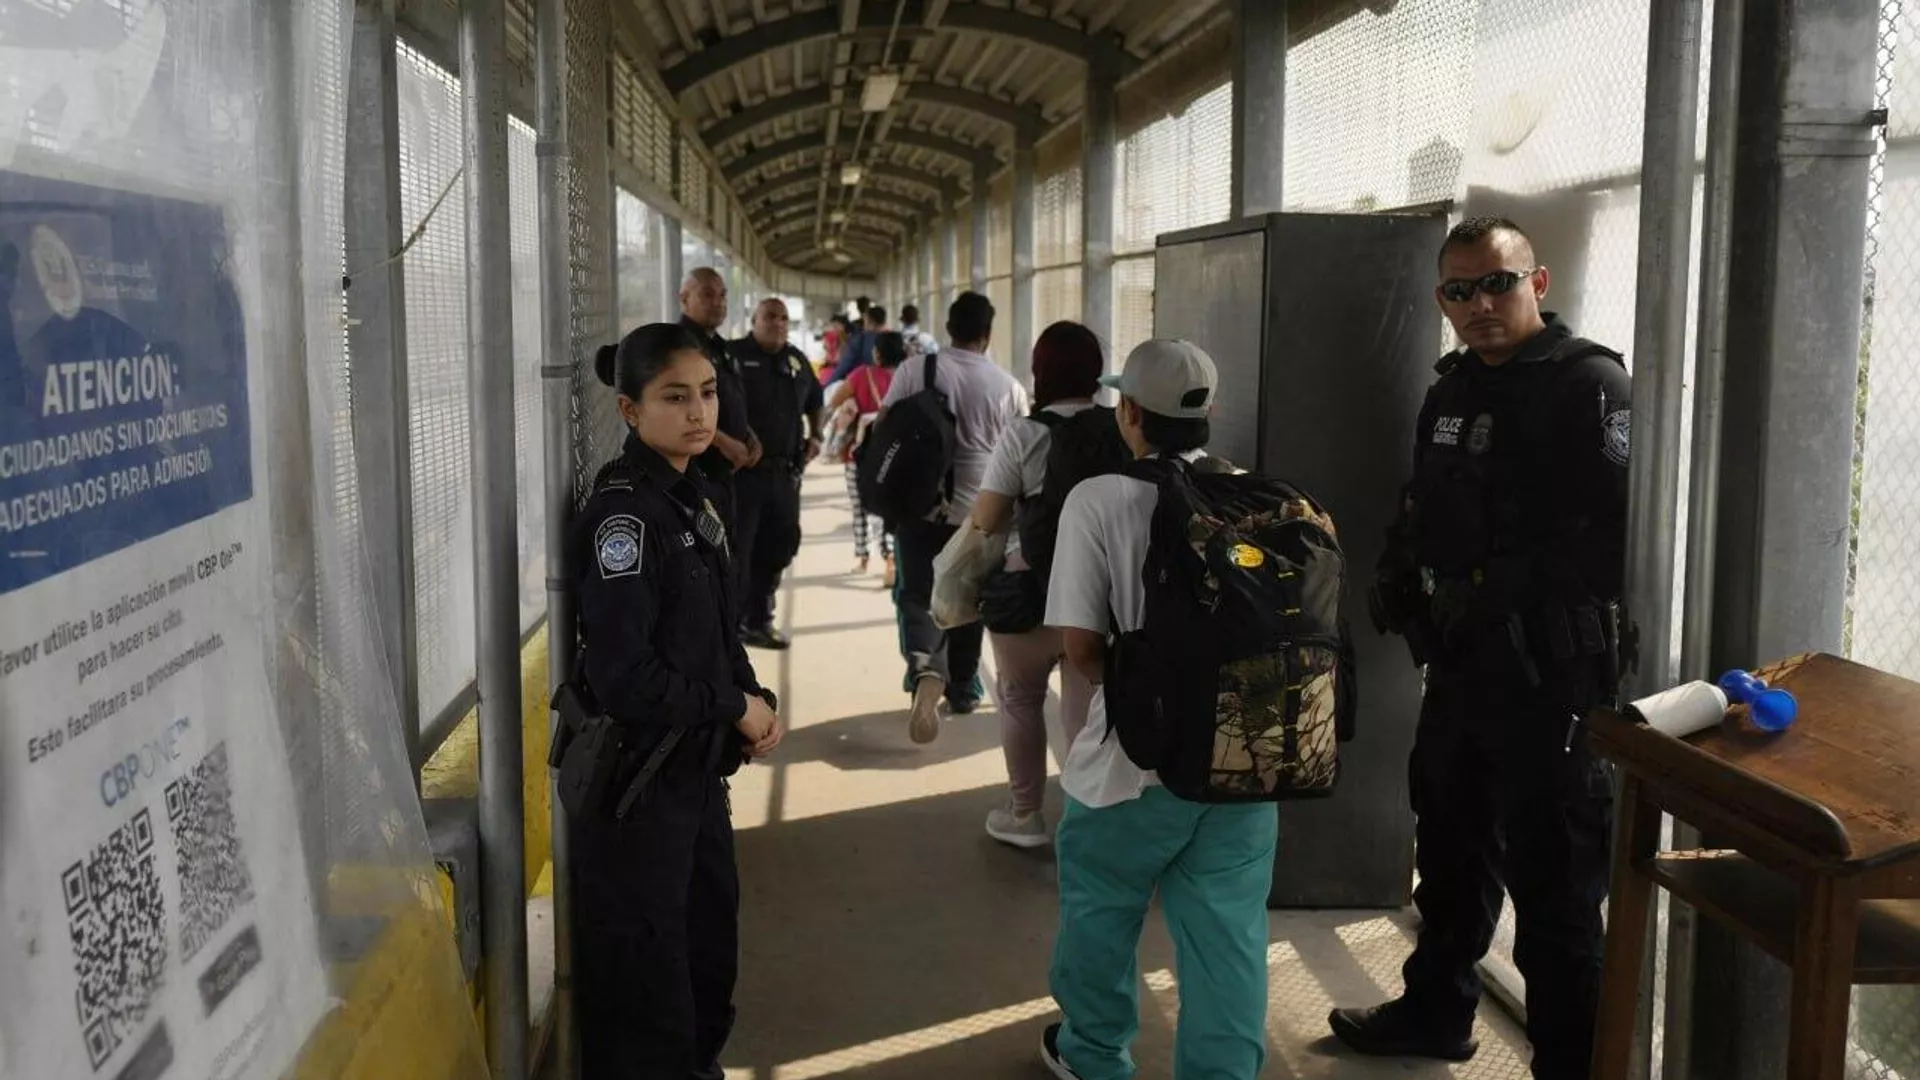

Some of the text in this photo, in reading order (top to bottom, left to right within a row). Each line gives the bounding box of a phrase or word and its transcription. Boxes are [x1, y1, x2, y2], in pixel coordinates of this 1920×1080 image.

[43, 343, 180, 416] ATENCIÓN:
[0, 427, 114, 479] CIUDADANOS
[117, 420, 143, 451] SIN
[0, 475, 107, 533] ADECUADOS
[110, 464, 150, 500] PARA
[90, 610, 103, 633] la
[197, 554, 218, 580] CBP
[77, 651, 108, 685] para
[108, 630, 145, 663] hacer
[28, 727, 65, 763] Esto
